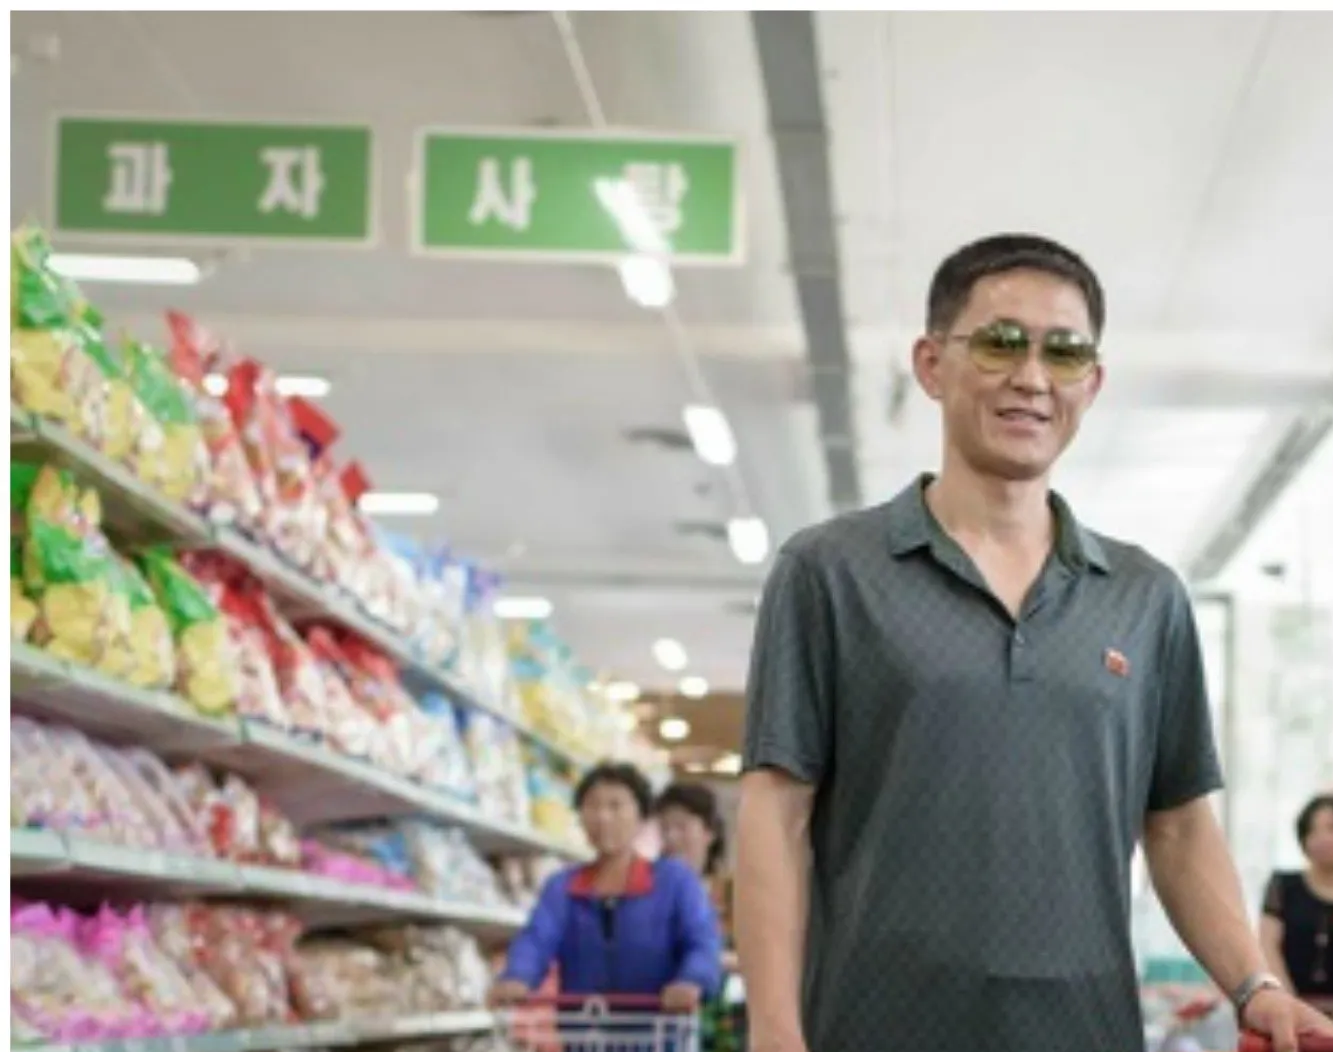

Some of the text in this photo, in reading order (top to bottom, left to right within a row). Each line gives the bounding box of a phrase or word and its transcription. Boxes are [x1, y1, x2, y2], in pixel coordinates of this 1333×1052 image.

[104, 140, 325, 221] 과 자
[469, 156, 537, 231] 사
